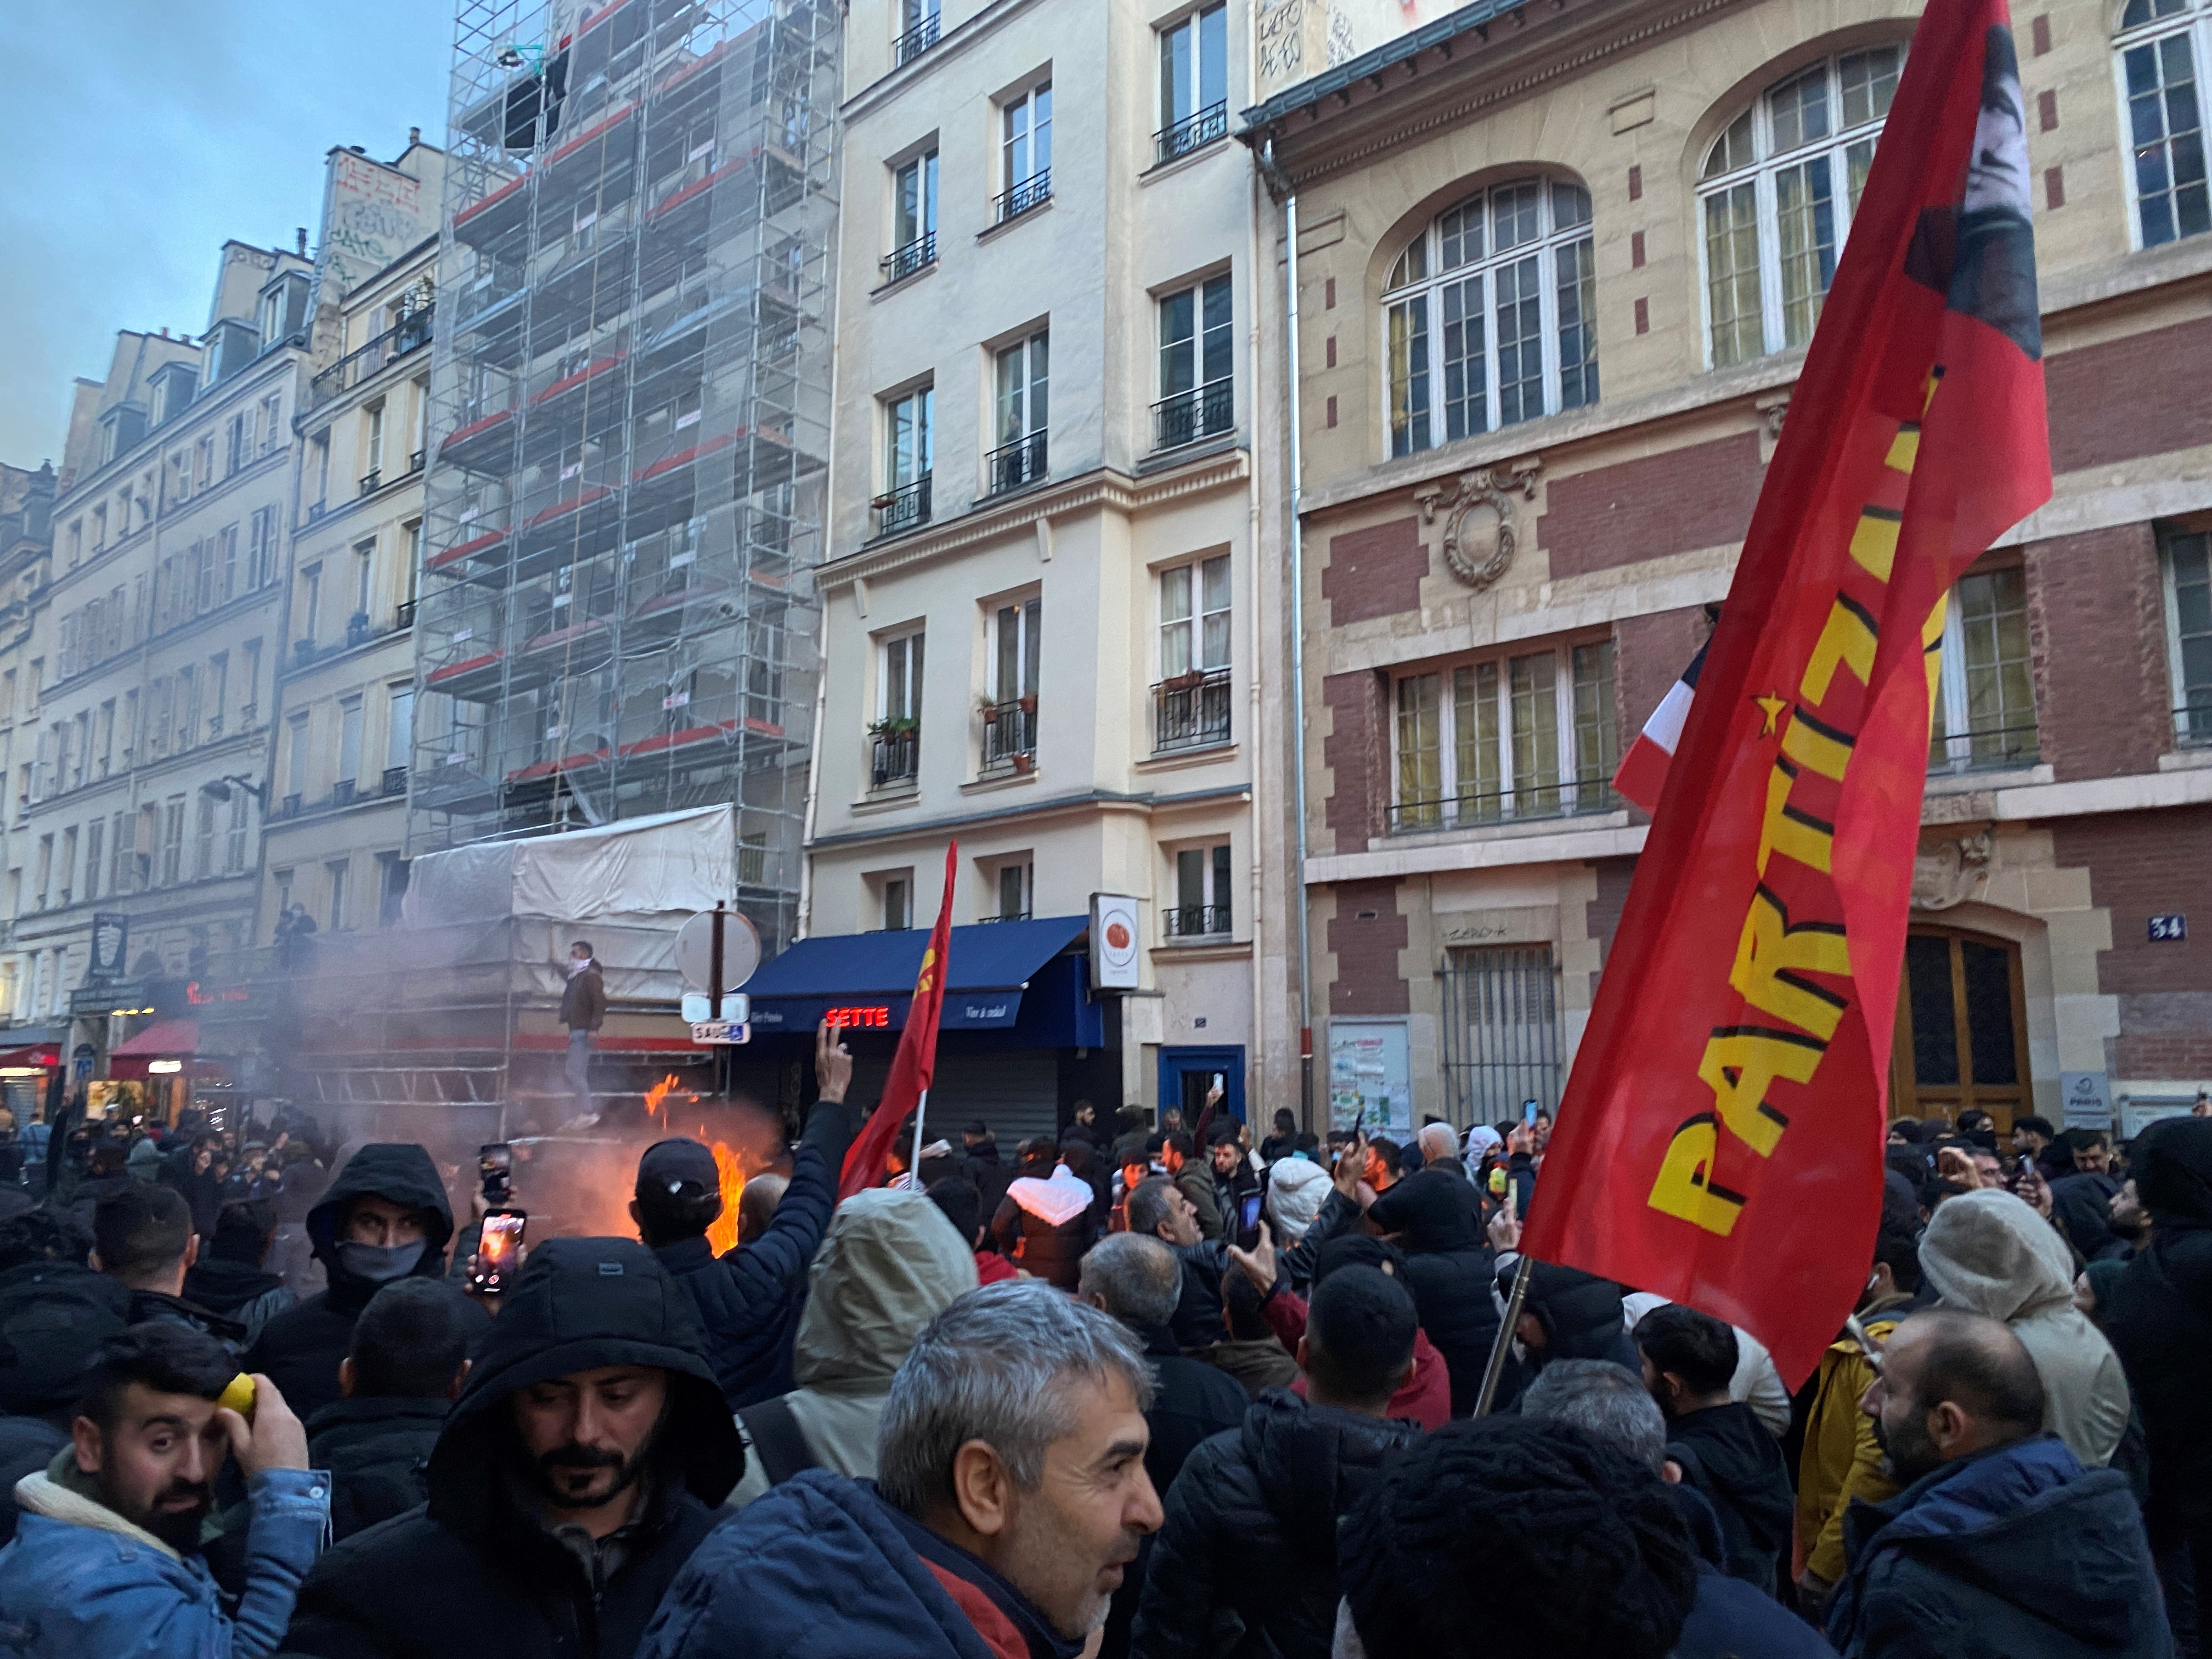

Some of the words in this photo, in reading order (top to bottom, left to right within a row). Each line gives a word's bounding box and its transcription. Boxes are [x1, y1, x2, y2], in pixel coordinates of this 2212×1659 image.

[2151, 917, 2181, 939] 34
[825, 1006, 889, 1028] SETTE
[2069, 1097, 2103, 1107] PARIS
